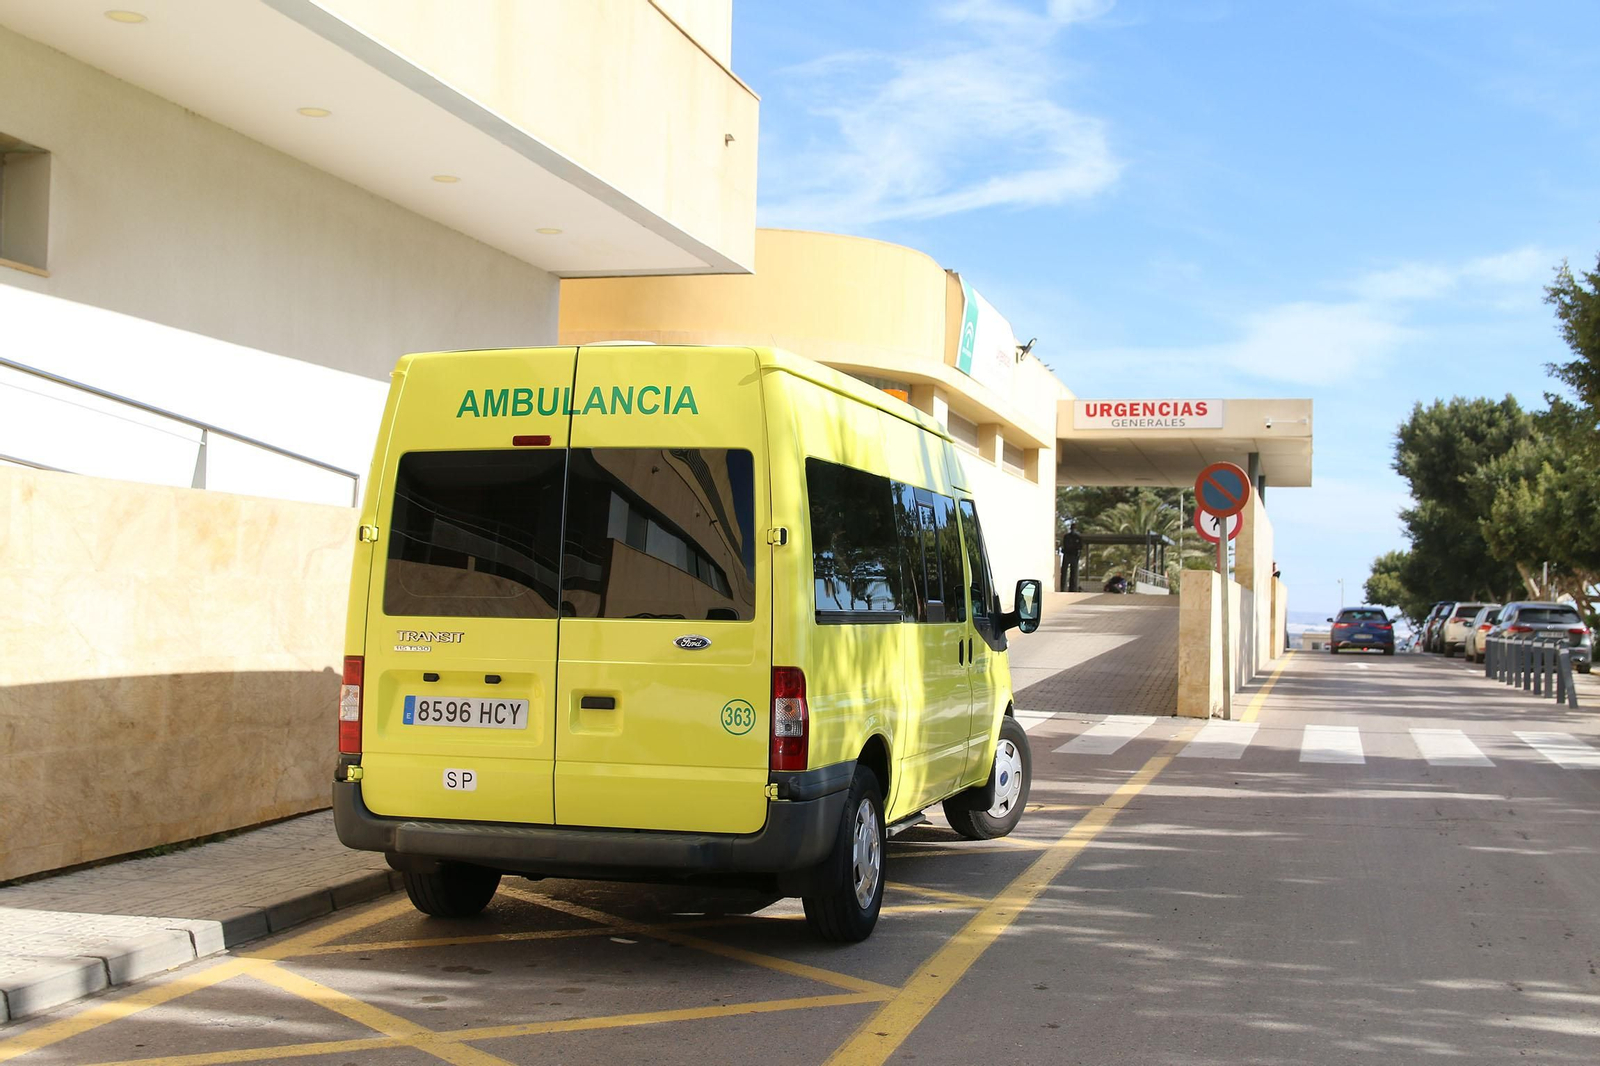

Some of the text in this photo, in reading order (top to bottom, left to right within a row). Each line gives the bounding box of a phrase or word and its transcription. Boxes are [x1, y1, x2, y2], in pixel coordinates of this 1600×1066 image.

[456, 385, 698, 418] AMBULANCIA
[1085, 401, 1208, 417] URGENCIAS
[1111, 418, 1186, 427] GENERALES
[396, 630, 465, 643] TRANSIT
[680, 637, 702, 647] Ford
[418, 700, 472, 723] 8596
[479, 702, 521, 725] HCY
[724, 707, 752, 727] 363
